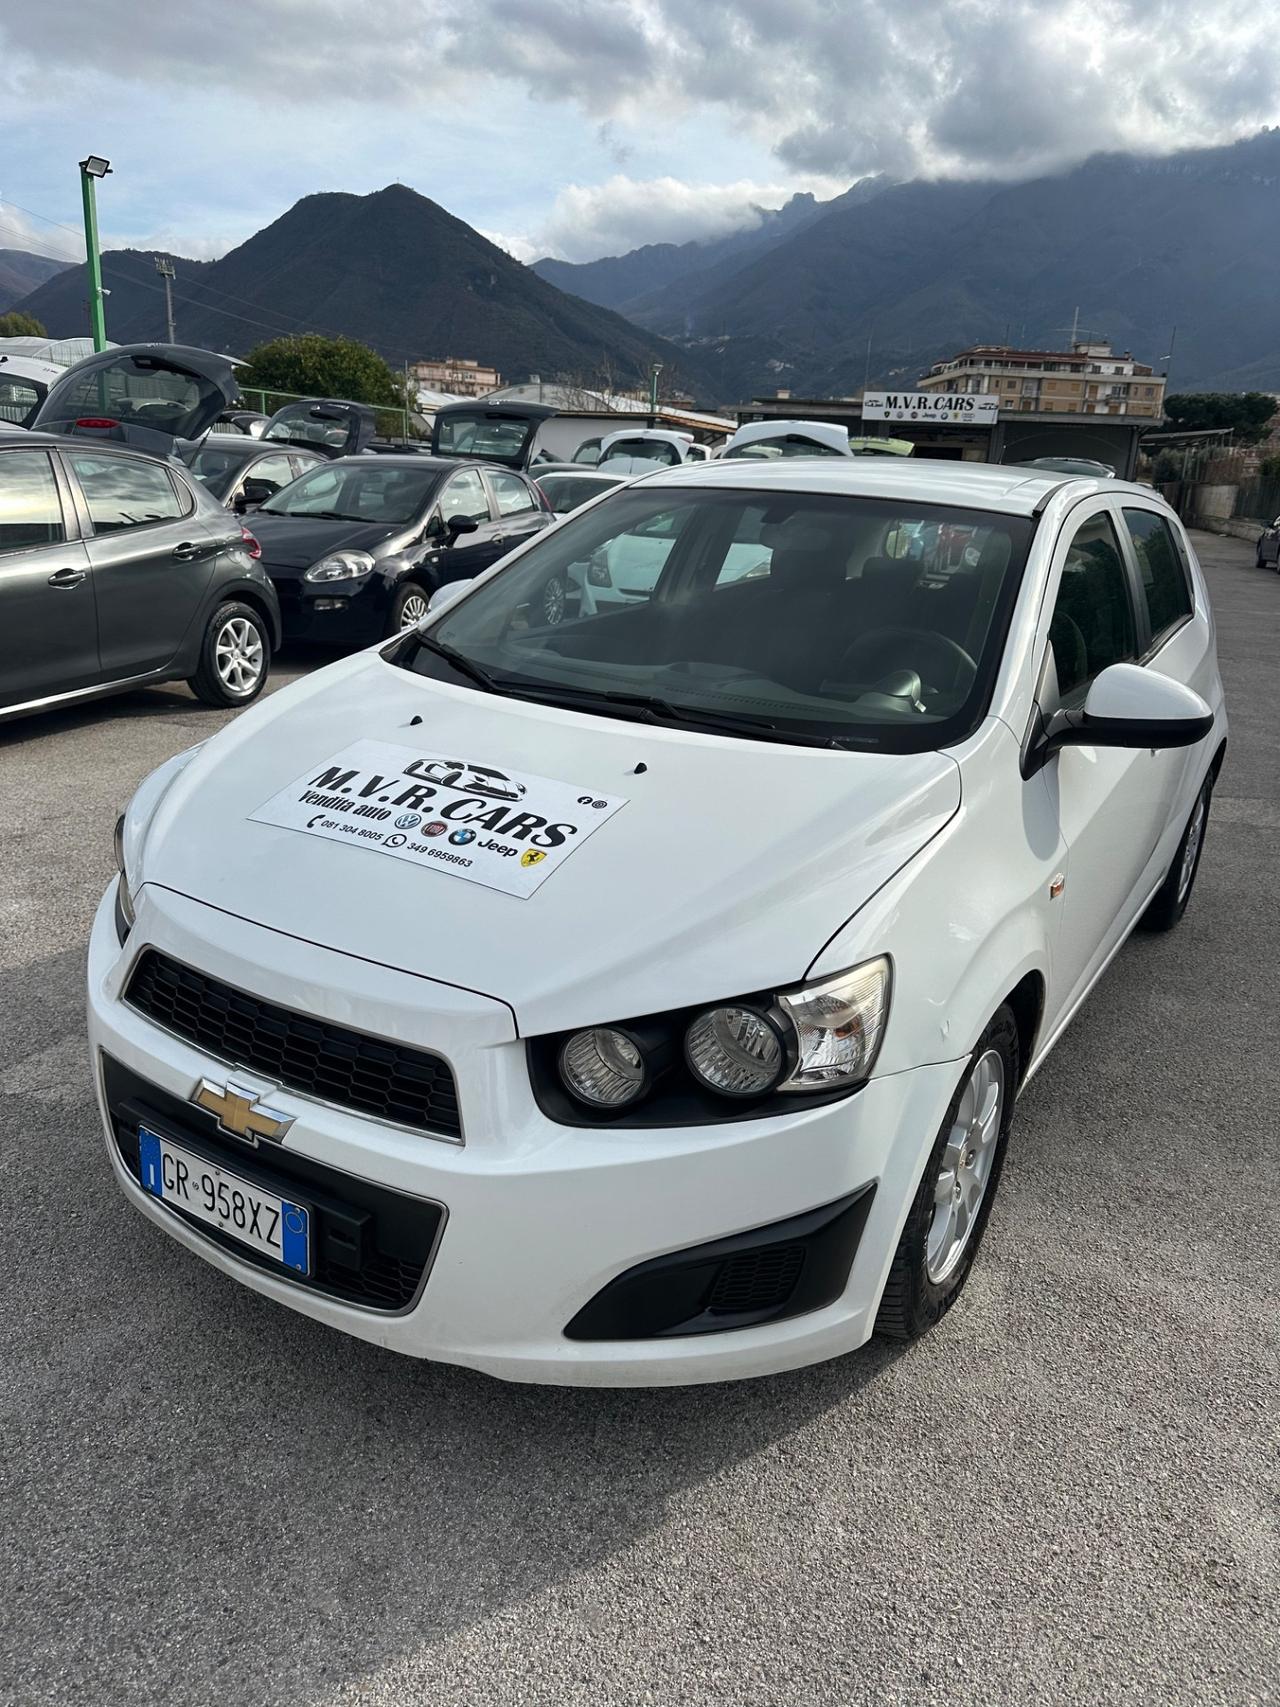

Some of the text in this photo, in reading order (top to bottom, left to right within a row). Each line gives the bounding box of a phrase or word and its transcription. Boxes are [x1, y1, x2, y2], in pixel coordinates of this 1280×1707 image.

[299, 790, 392, 822] Vendita auto
[321, 820, 339, 830] 081
[339, 824, 358, 835] 304
[407, 842, 473, 868] 349 6959863
[478, 839, 519, 858] Jeep
